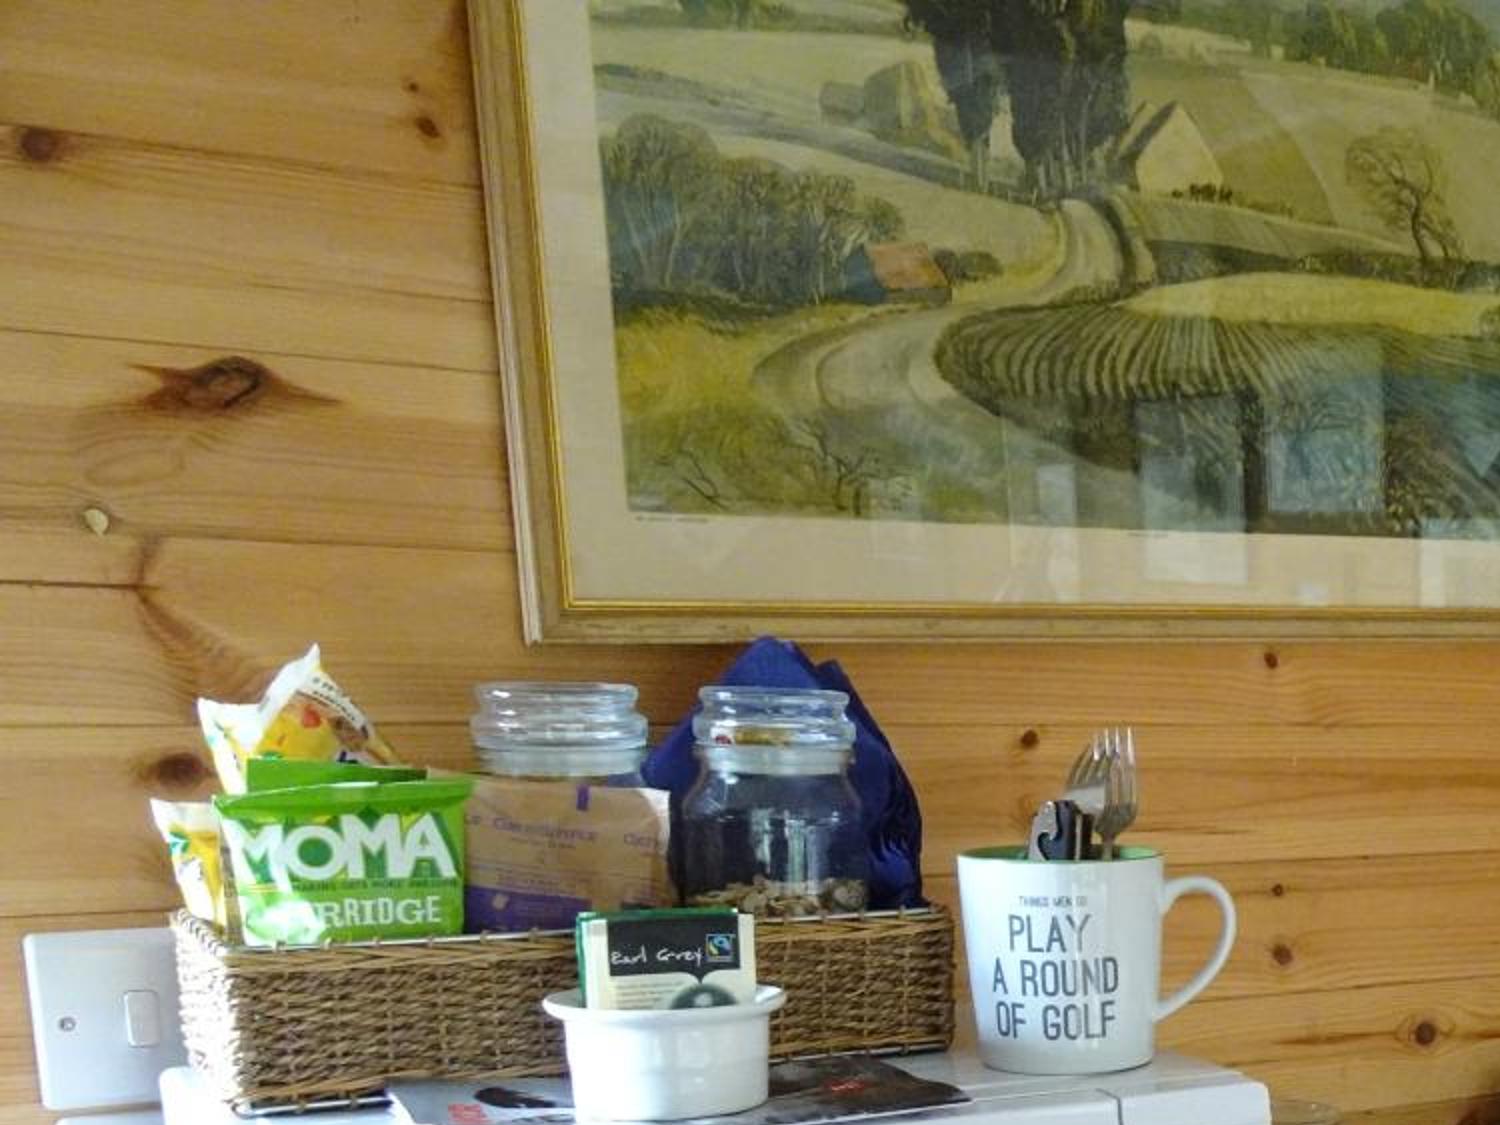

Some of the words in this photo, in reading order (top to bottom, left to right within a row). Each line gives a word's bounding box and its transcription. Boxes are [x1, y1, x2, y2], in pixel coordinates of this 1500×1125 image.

[222, 812, 458, 893] MOMA
[1008, 914, 1091, 953] PLAY
[611, 945, 647, 965] Earl
[656, 946, 702, 968] Grey
[993, 957, 1008, 994] A
[1020, 957, 1119, 997] ROUND
[996, 1001, 1027, 1039] OF
[1043, 1001, 1116, 1041] GOLF
